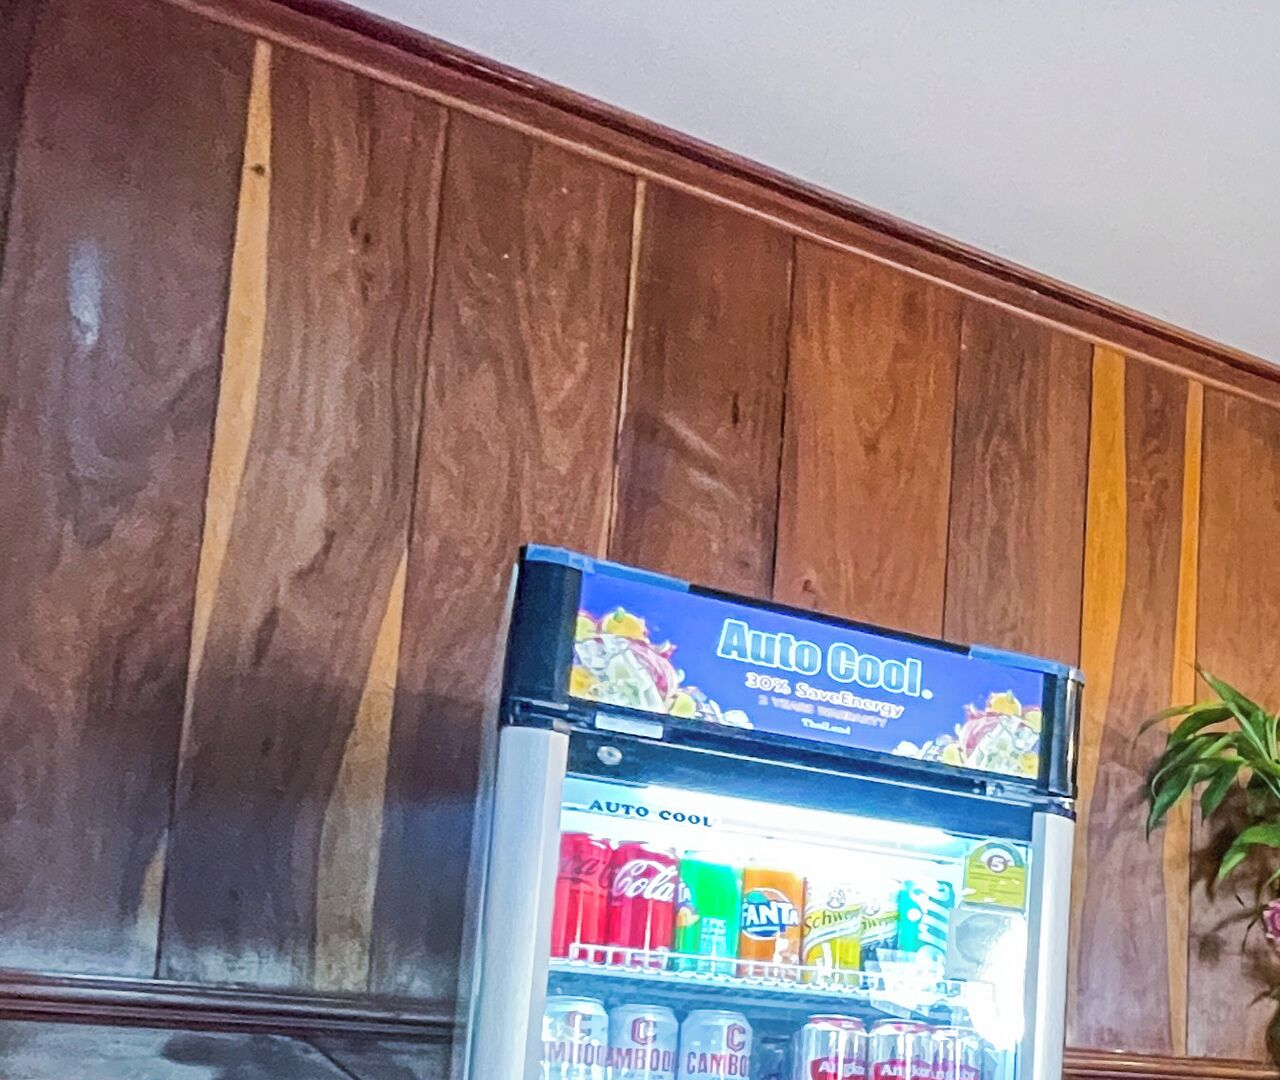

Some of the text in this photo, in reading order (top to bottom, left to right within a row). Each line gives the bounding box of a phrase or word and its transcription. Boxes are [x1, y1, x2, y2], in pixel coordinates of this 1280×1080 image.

[717, 618, 822, 676] Auto
[745, 672, 791, 695] 30%
[589, 799, 713, 827] AUTO COOL
[726, 1023, 746, 1053] C
